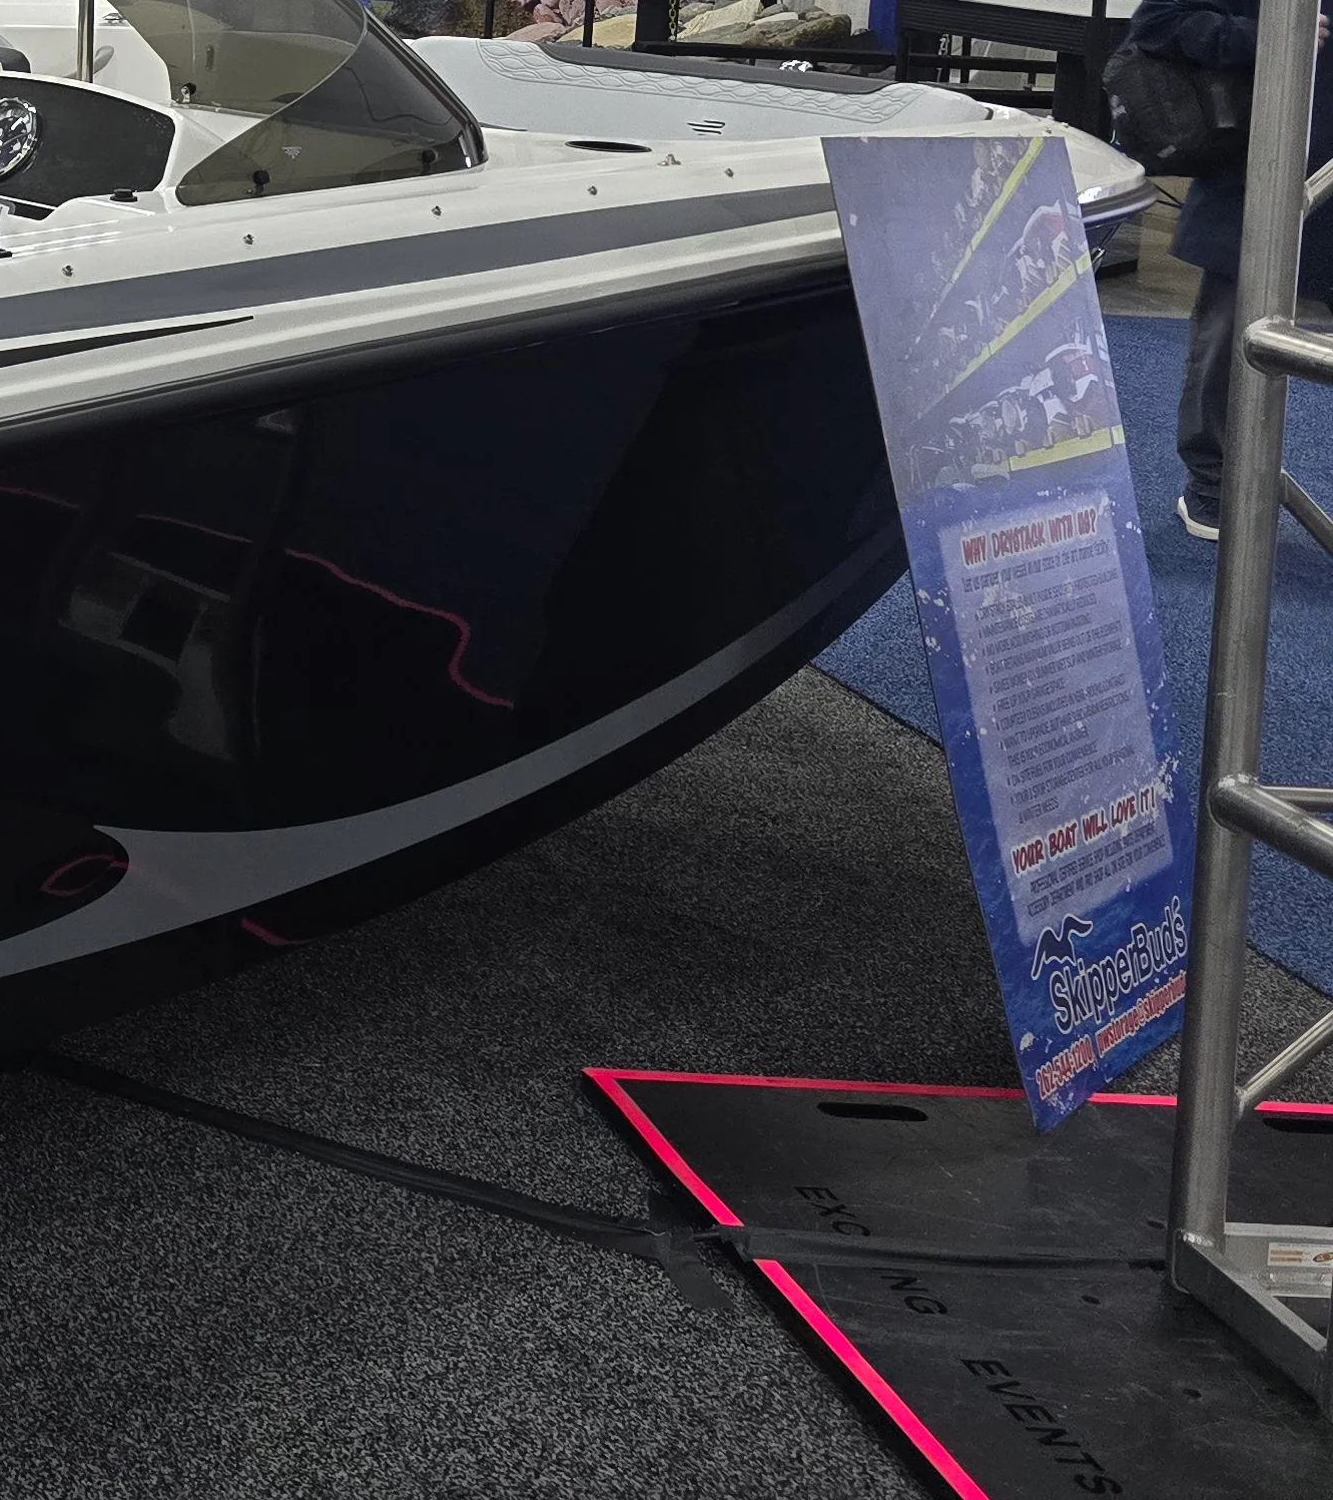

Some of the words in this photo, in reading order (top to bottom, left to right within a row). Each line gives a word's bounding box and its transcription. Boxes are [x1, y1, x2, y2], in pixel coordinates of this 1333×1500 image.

[962, 535, 987, 566] WHY
[1048, 513, 1074, 543] WITH
[1013, 838, 1045, 874] YOUR
[1049, 822, 1078, 858] BOAT
[1083, 809, 1108, 841] WILL
[1111, 795, 1136, 828] LOVE
[1049, 895, 1188, 1035] SkipperBud's
[960, 1358, 1124, 1495] EVENTS
